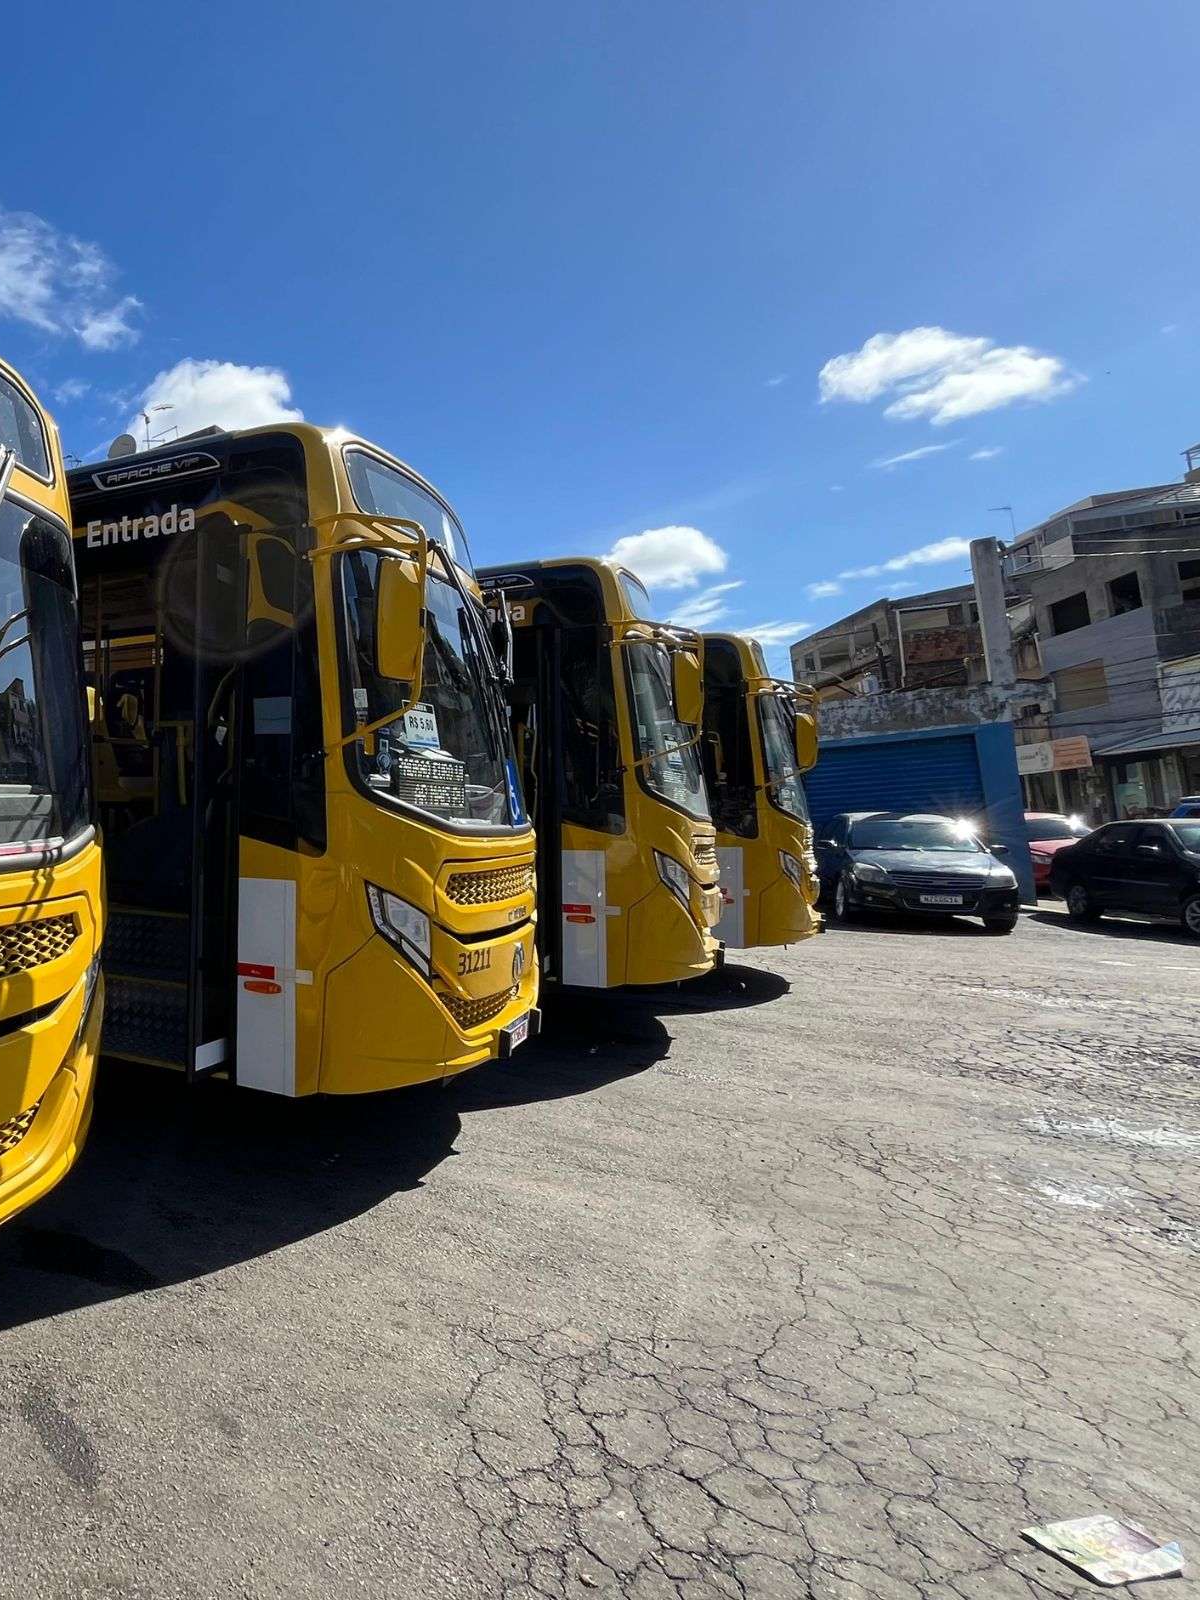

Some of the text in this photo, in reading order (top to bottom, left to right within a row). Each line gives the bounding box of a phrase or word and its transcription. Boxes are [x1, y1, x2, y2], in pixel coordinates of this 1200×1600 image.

[106, 456, 200, 484] APACHE VIP
[87, 503, 196, 548] Entrada
[457, 946, 492, 977] 31211
